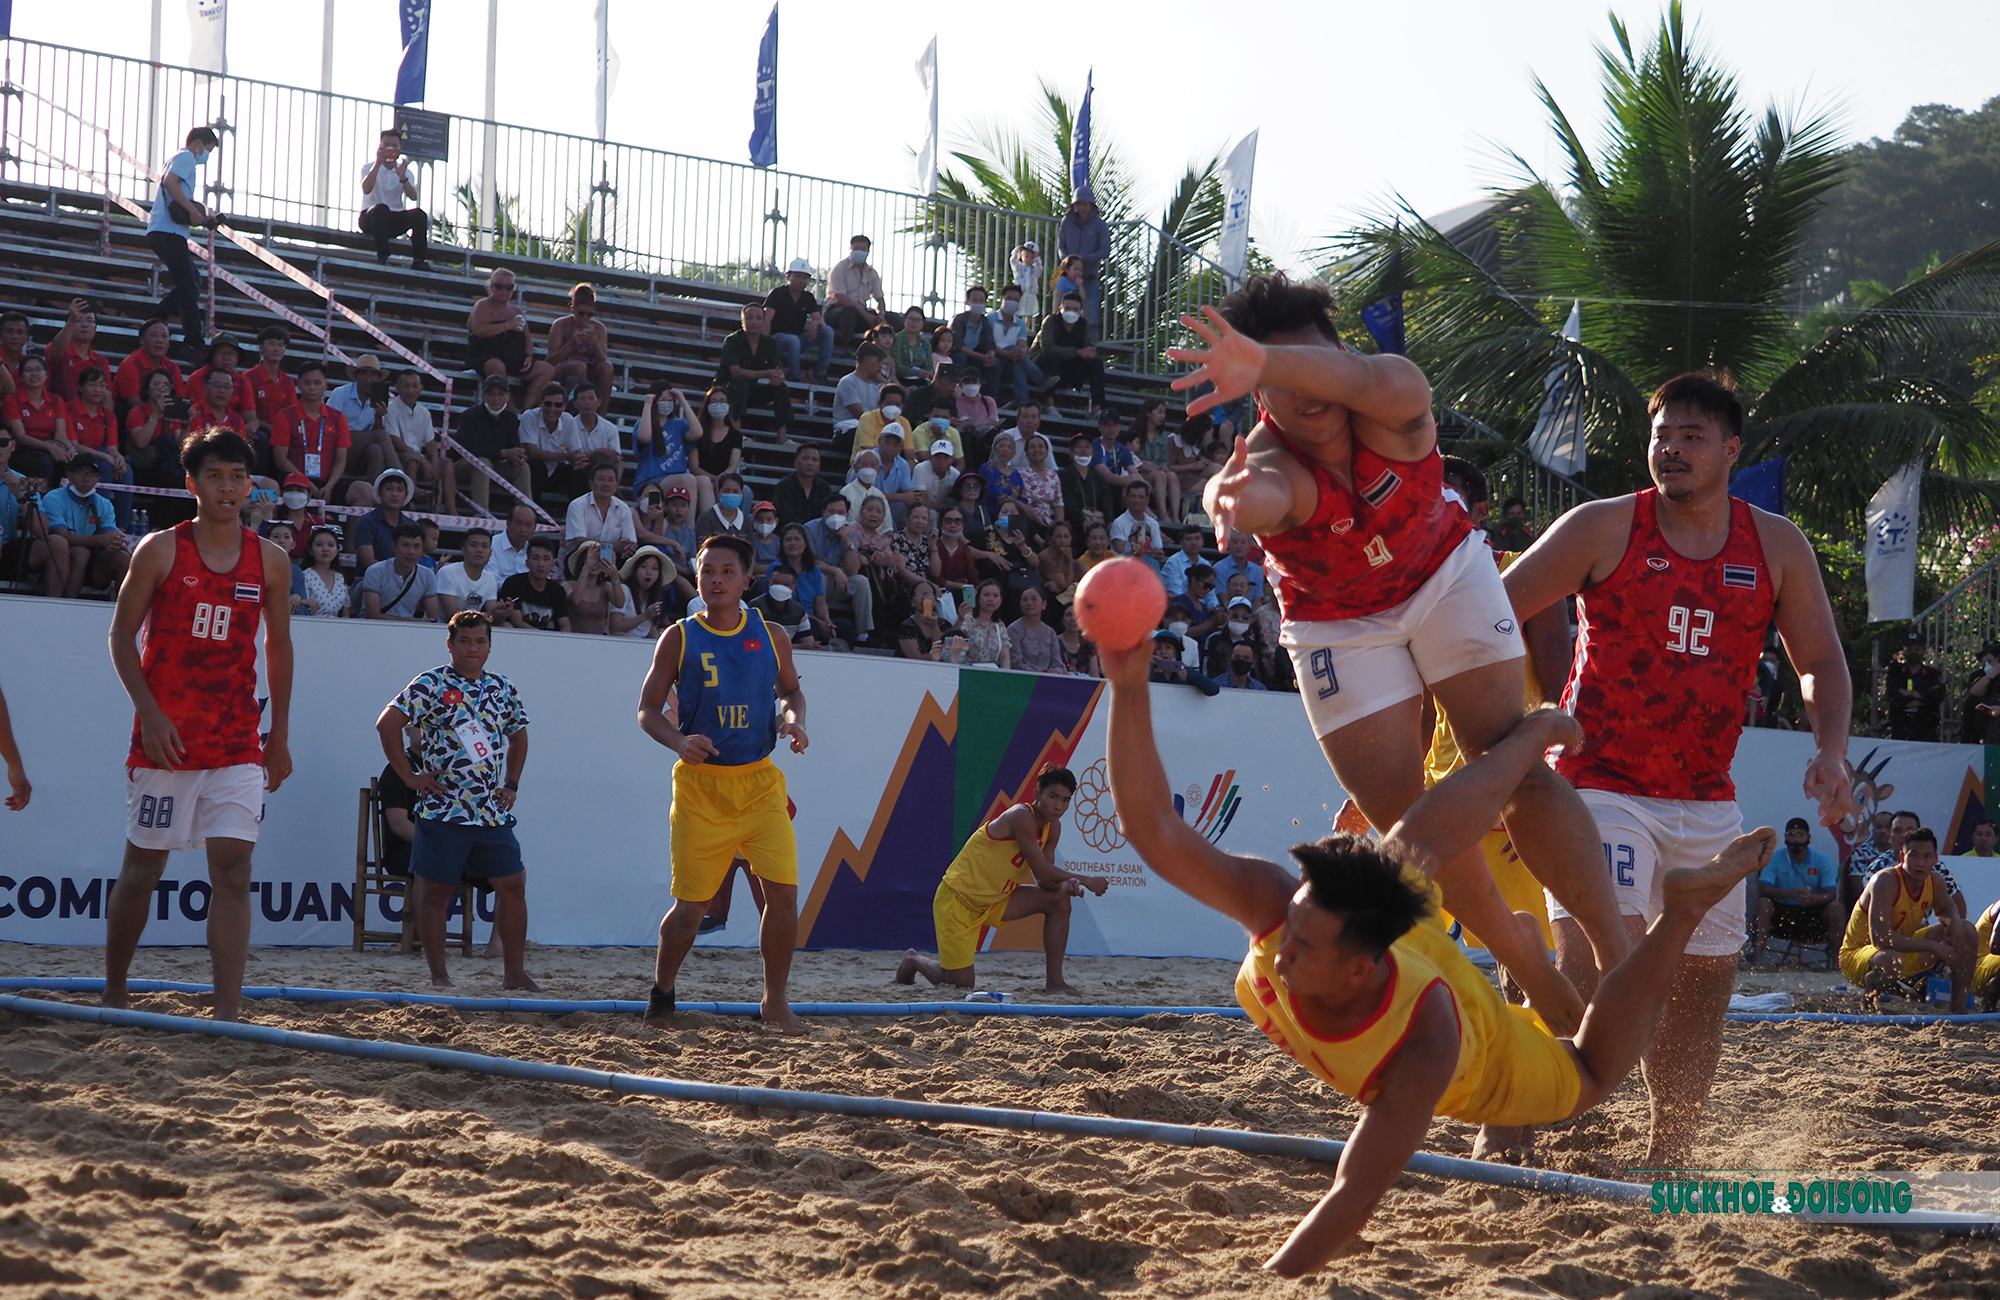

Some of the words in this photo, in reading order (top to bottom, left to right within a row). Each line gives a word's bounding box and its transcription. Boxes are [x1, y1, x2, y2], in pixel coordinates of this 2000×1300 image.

[192, 602, 232, 641] 88
[1666, 605, 1714, 656] 92
[701, 653, 719, 687] 5
[1310, 647, 1339, 700] 9
[717, 705, 749, 728] VIE
[474, 742, 488, 758] B
[138, 795, 174, 828] 88
[1064, 861, 1116, 873] SOUTHEAST
[1117, 864, 1143, 874] ASIAN
[152, 880, 213, 922] TO
